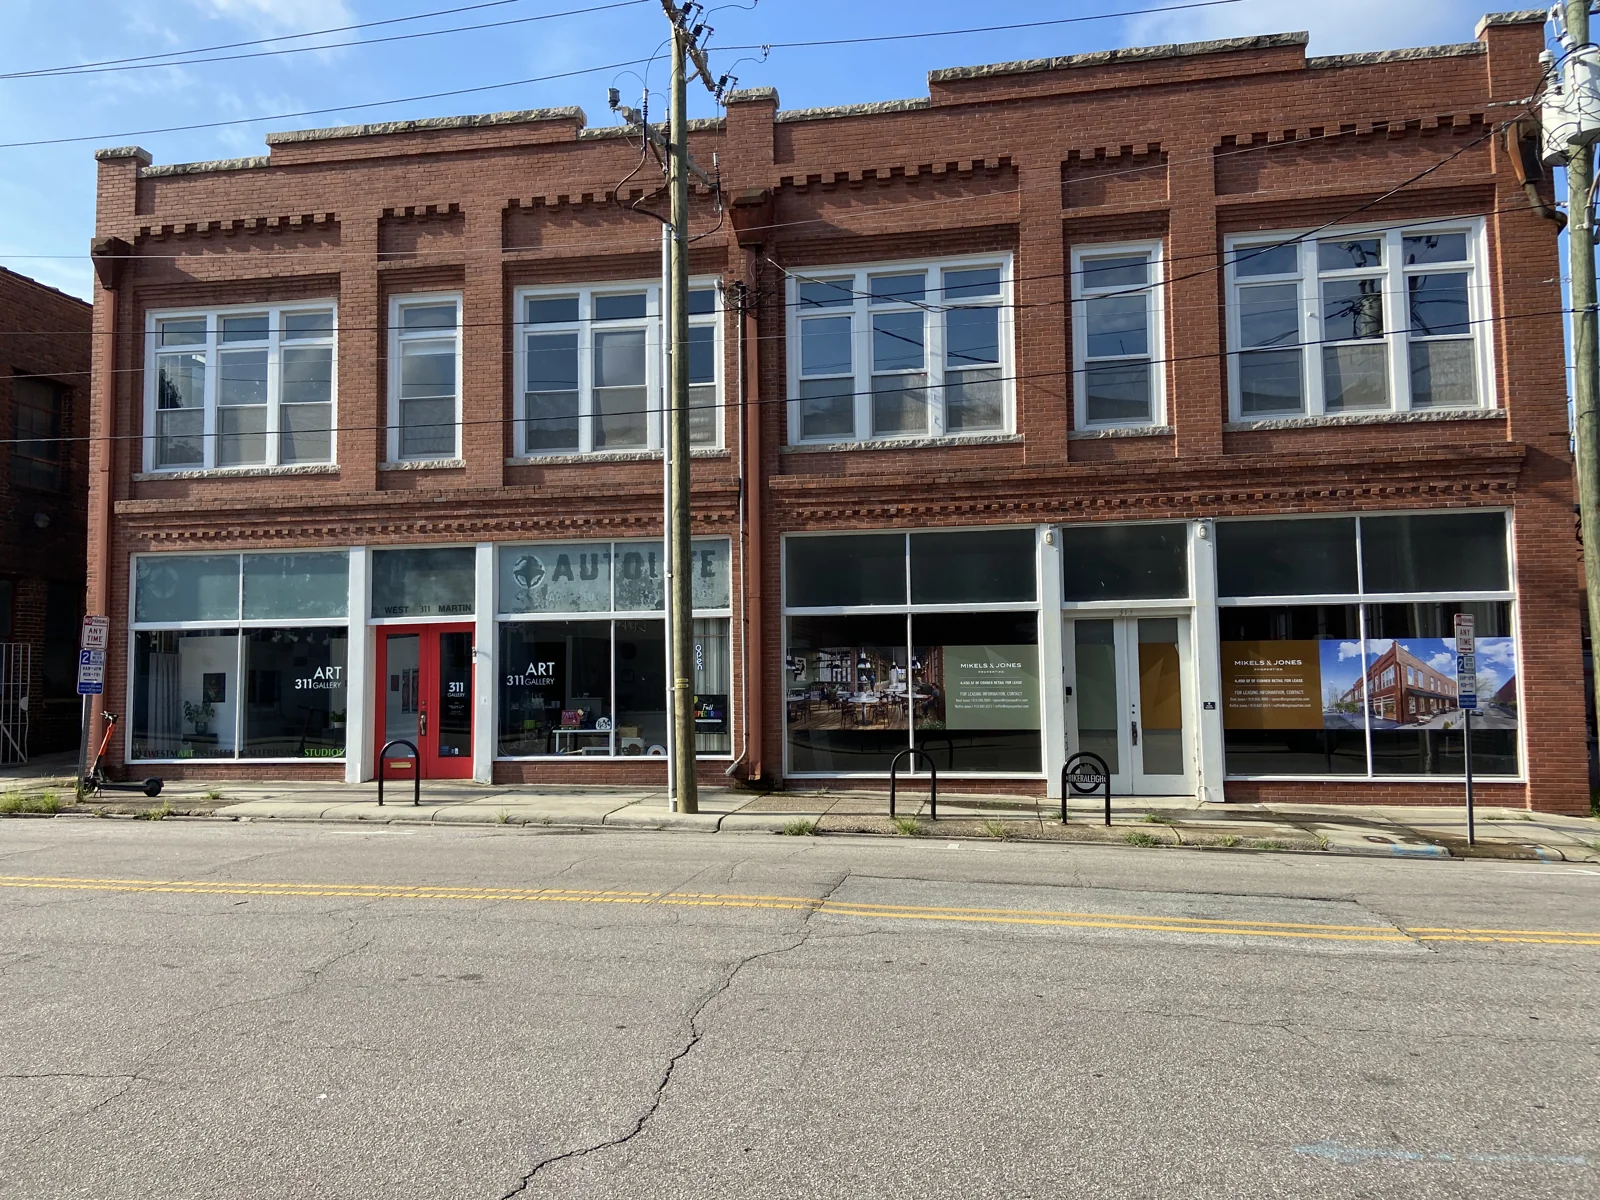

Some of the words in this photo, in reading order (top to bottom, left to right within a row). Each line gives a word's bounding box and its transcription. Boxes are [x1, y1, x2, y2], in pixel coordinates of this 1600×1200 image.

[552, 550, 716, 582] AUTOLE
[384, 606, 409, 614] WEST
[420, 605, 431, 613] 311
[438, 604, 472, 612] MARTIN
[87, 635, 103, 643] TIME
[1460, 638, 1471, 646] TIME
[82, 652, 90, 663] 2
[525, 662, 556, 676] ART
[1458, 658, 1464, 671] 2
[313, 666, 342, 680] ART
[294, 678, 312, 689] 311
[506, 675, 524, 686] 311
[524, 677, 555, 686] GALLERY
[448, 682, 464, 692] 311
[304, 747, 344, 758] STUDIOS
